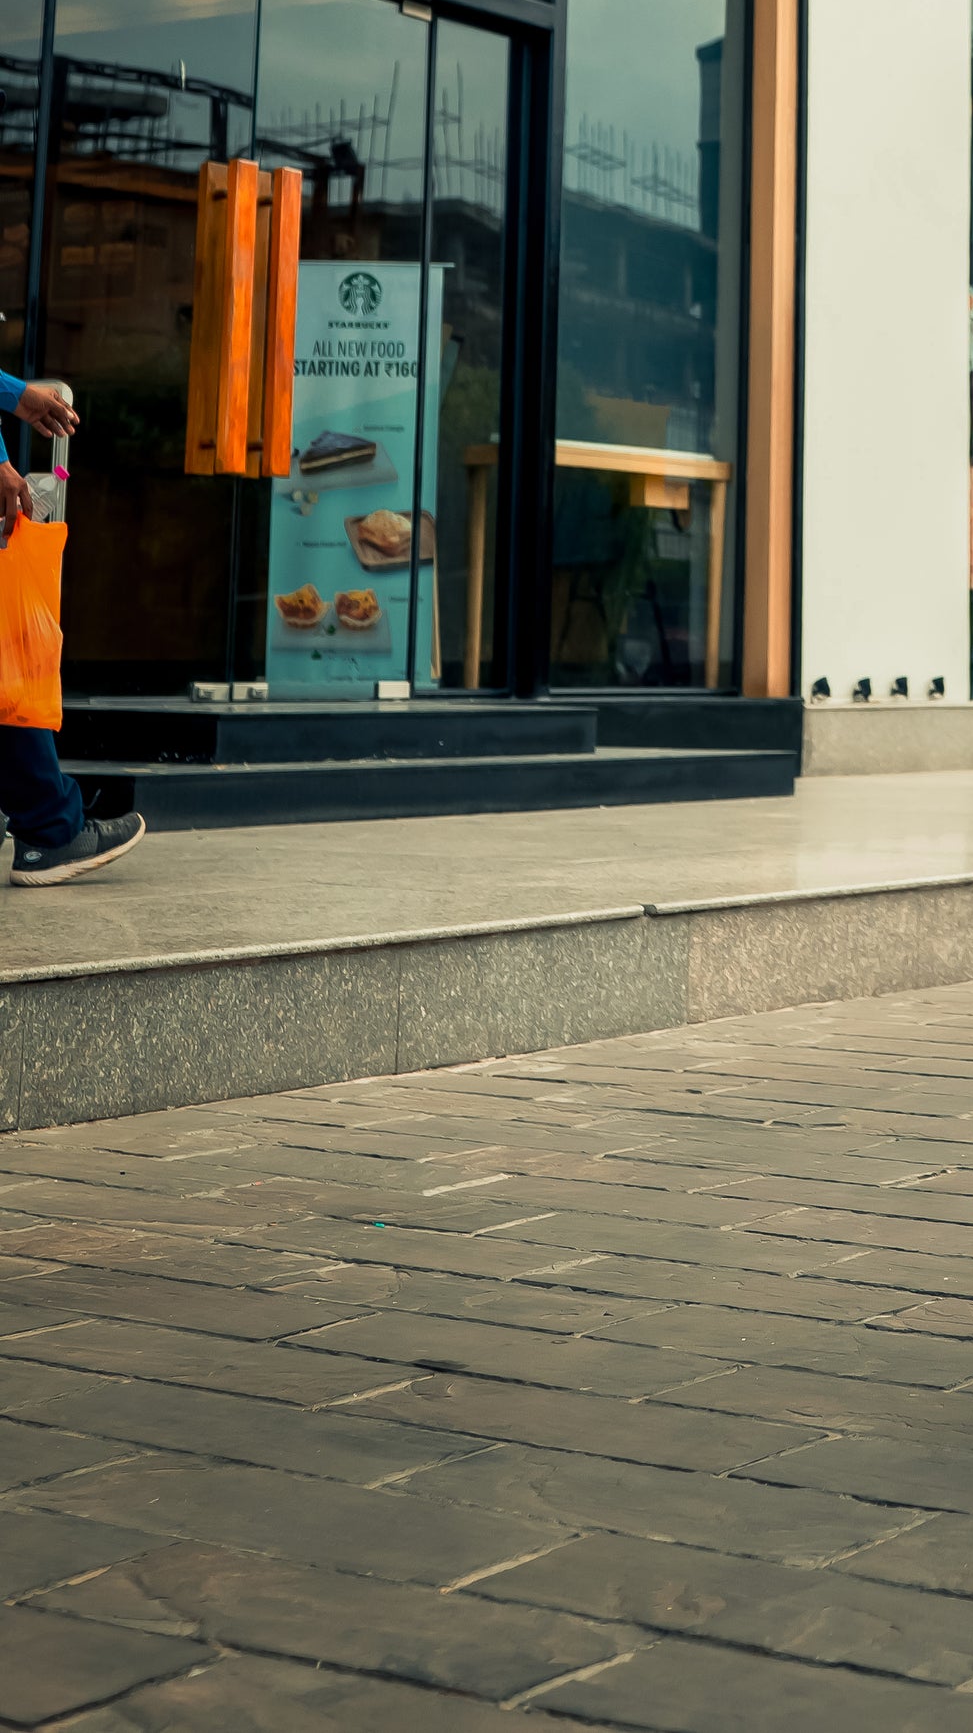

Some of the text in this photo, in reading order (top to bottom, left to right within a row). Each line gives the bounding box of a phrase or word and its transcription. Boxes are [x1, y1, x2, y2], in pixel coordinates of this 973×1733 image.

[328, 321, 388, 330] STARBUCKS
[312, 341, 405, 358] ALL NEW FOOD
[293, 360, 360, 377] STARTING
[364, 361, 380, 376] AT
